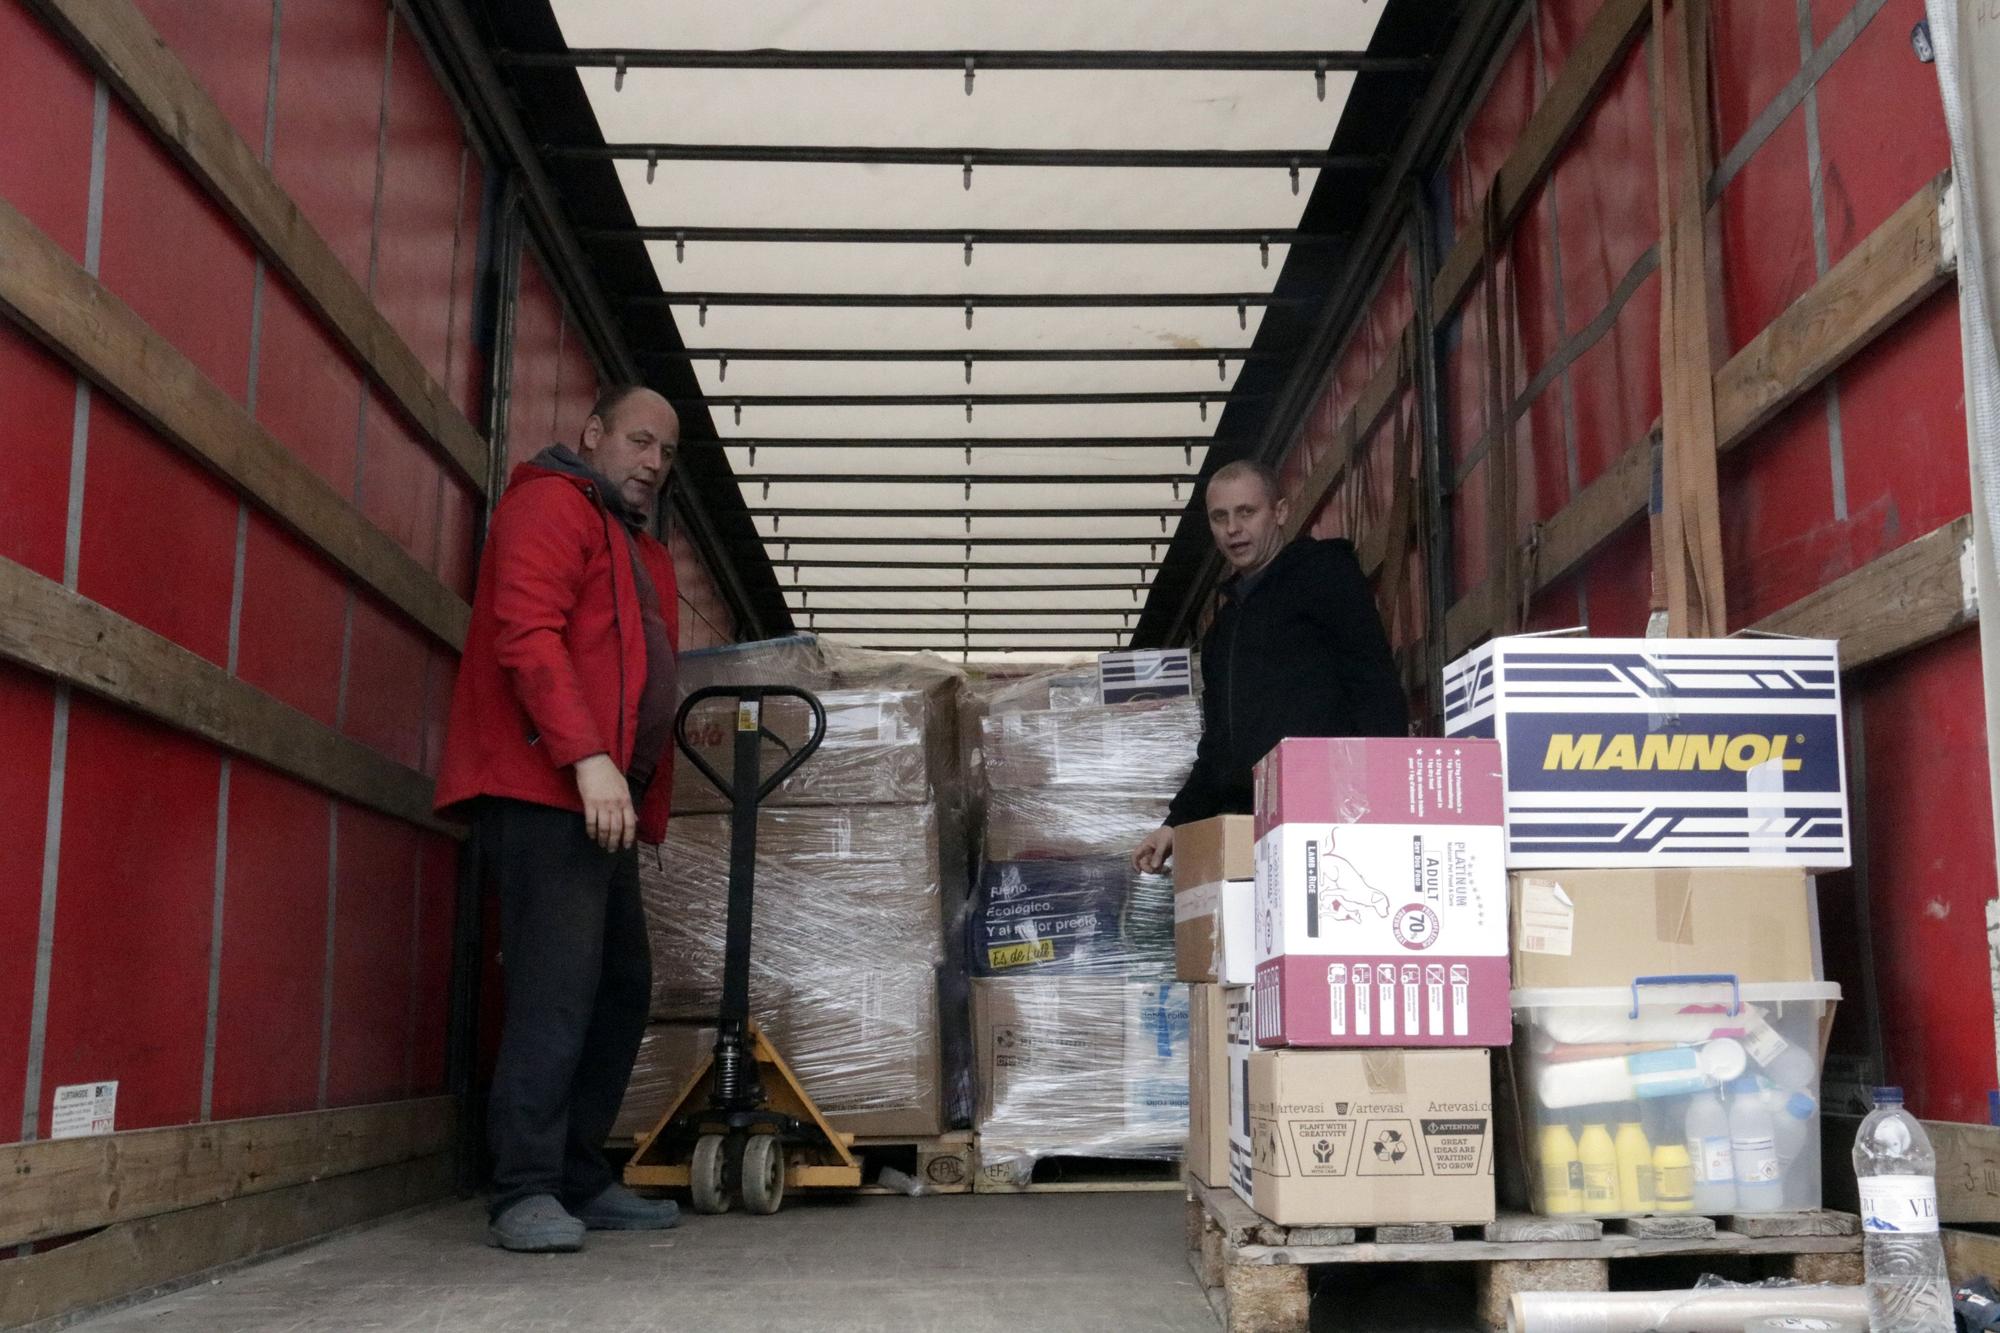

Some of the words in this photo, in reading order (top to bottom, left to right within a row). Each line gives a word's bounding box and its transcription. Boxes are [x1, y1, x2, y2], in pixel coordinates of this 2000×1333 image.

[1542, 734, 1802, 771] MANNOL
[1414, 856, 1422, 868] DOG
[1426, 858, 1439, 901] ADULT
[1454, 842, 1467, 906] PLATINUM
[1308, 875, 1317, 894] RICE
[986, 926, 995, 937] Y
[999, 925, 1010, 936] al
[1440, 1138, 1468, 1146] GREAT
[1433, 1146, 1458, 1154] IDEAS
[1436, 1154, 1473, 1162] WAITING
[1436, 1162, 1448, 1170] TO
